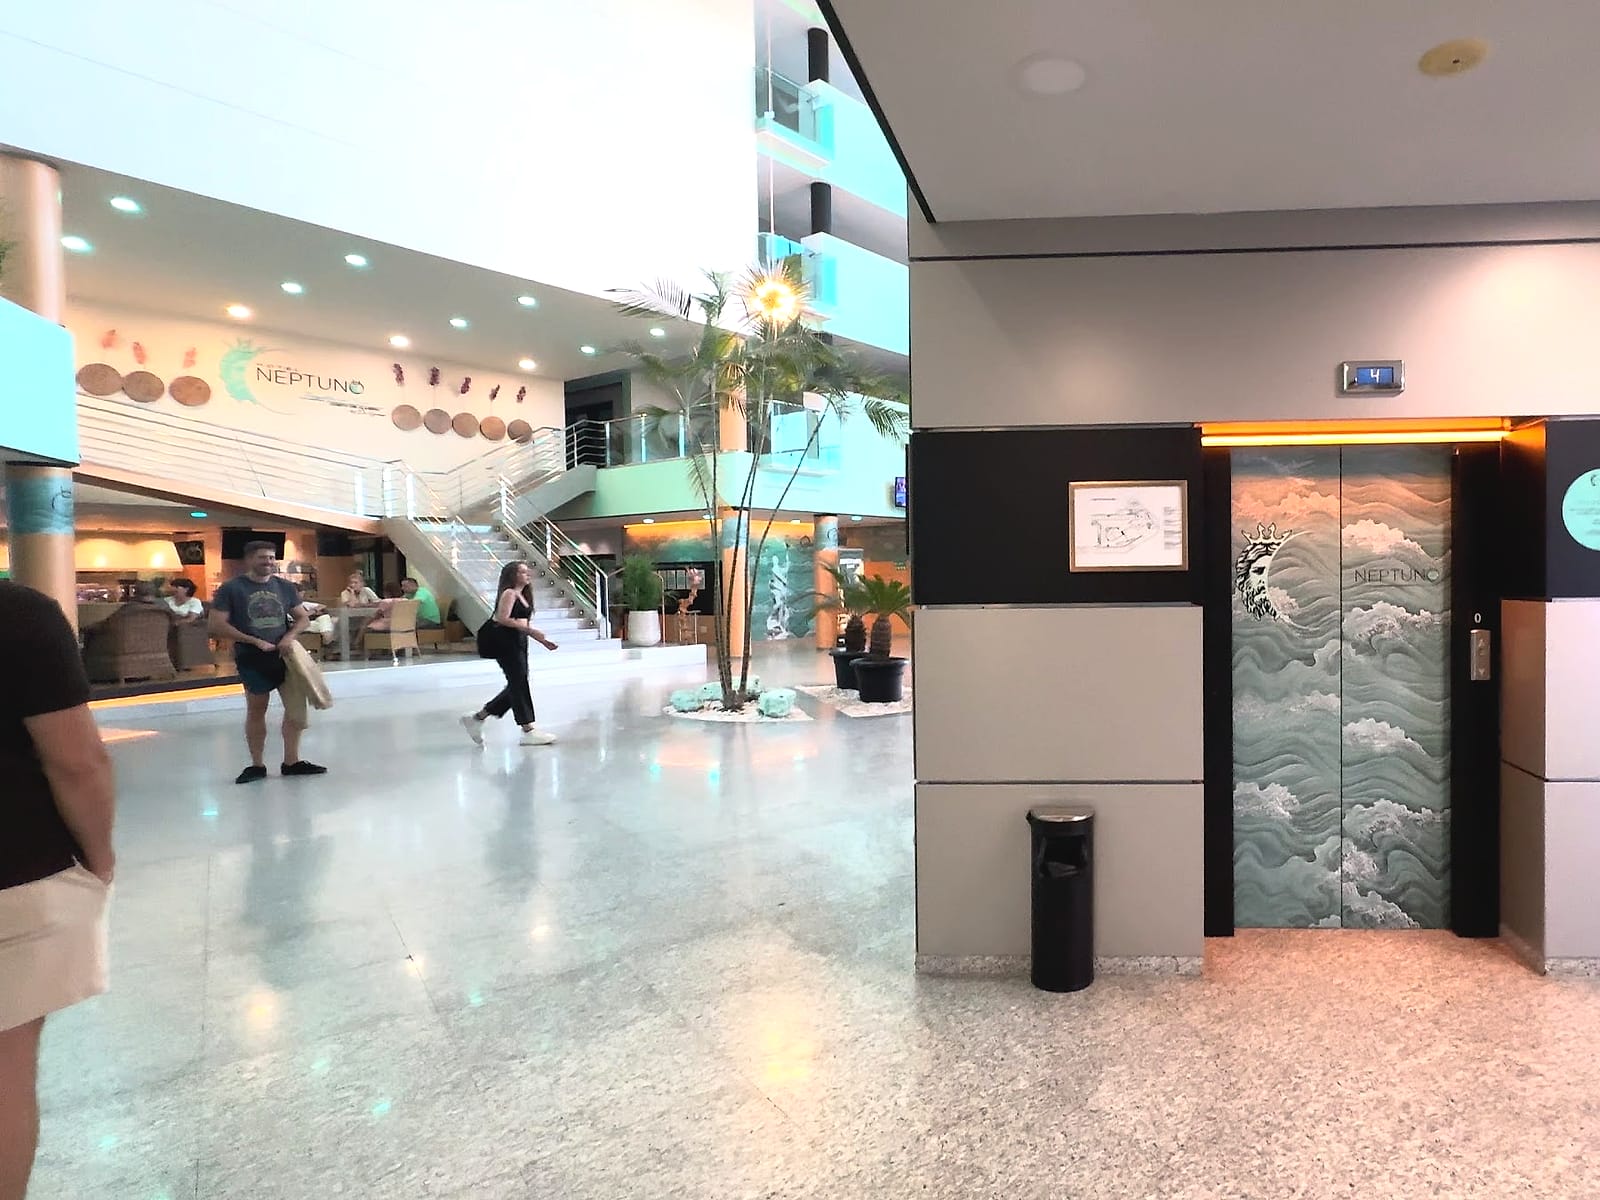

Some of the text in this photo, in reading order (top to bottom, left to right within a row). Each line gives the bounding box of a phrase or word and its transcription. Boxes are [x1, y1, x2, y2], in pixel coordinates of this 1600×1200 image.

[256, 366, 365, 395] NEPTUNO
[1370, 368, 1380, 384] 4
[1353, 567, 1440, 585] NEPTUNO
